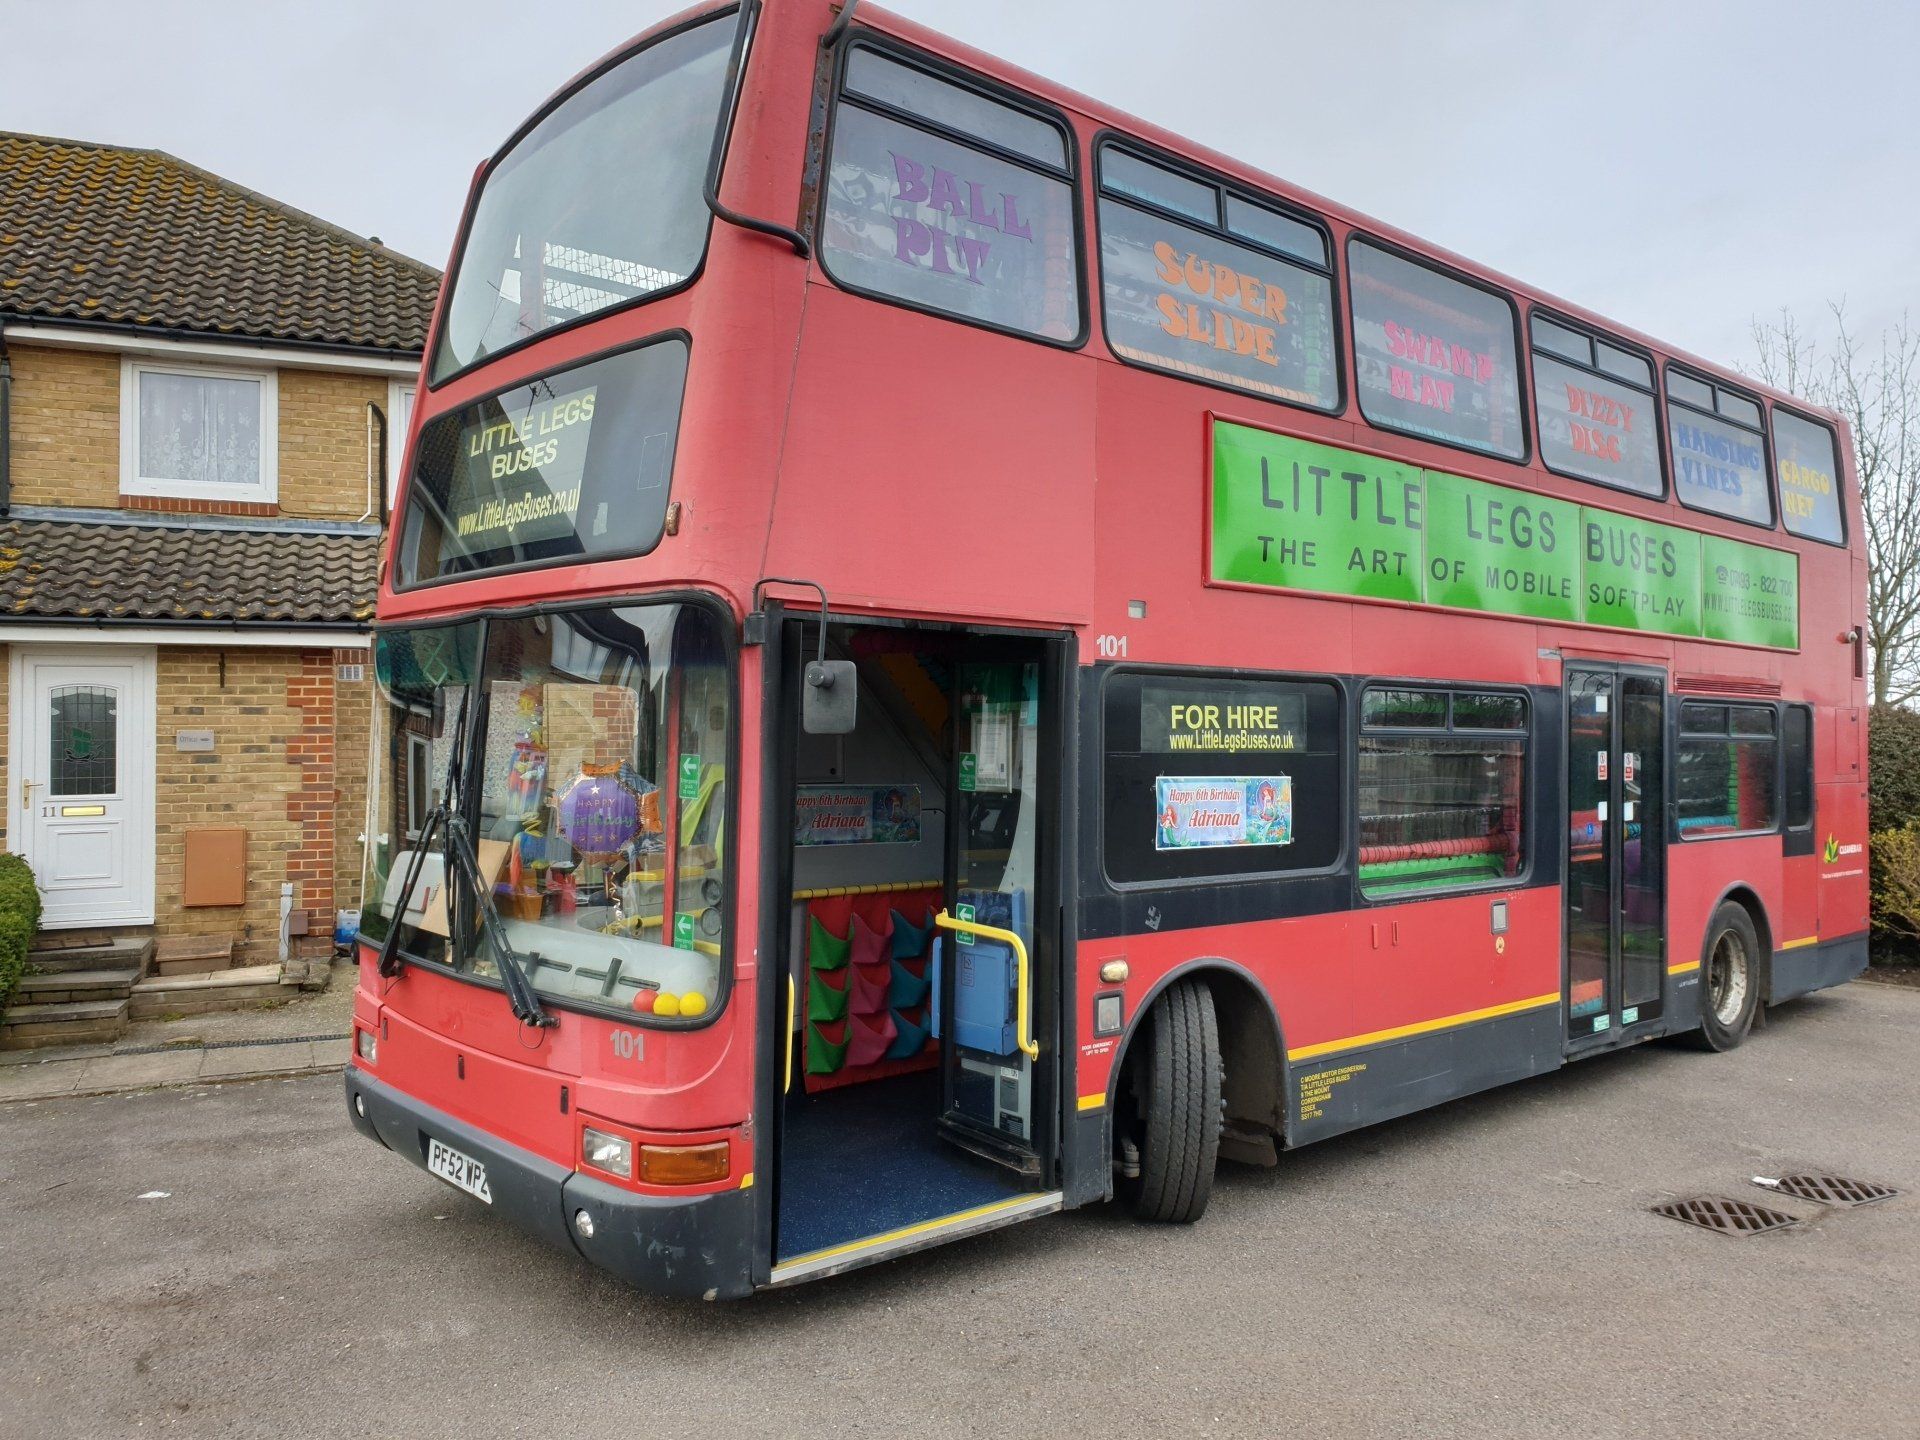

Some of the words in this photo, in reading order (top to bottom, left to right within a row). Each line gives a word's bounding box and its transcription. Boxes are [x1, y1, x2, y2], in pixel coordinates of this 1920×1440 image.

[888, 150, 1033, 243] BALL
[889, 216, 992, 286] PIT
[1152, 241, 1288, 325] SUPER
[1155, 293, 1281, 367] SLIDE
[1384, 319, 1494, 385] SWAMP
[1388, 364, 1455, 414] MAT
[1565, 382, 1635, 432] DIZZY
[470, 415, 534, 457] LITTLE
[539, 393, 597, 436] LEGS
[1568, 420, 1622, 464] DISC
[491, 438, 559, 479] BUSES
[1677, 422, 1760, 471] HANGING
[1681, 456, 1744, 497] VINES
[1779, 459, 1830, 496] CARGO
[1261, 455, 1422, 530] LITTLE
[1465, 494, 1556, 553] LEGS
[1586, 522, 1677, 578] BUSES
[1783, 490, 1815, 519] NET
[1257, 535, 1317, 567] THE
[1348, 546, 1408, 576] ART
[1430, 557, 1466, 583] OF
[1486, 565, 1572, 599] MOBILE
[1589, 583, 1685, 617] SOFTPLAY
[1760, 575, 1777, 593] 822
[1096, 634, 1127, 657] 101
[1171, 705, 1220, 729] FOR
[1227, 705, 1279, 729] HIRE
[1169, 729, 1294, 752] www.LittleLegsBuses.co.uk
[41, 806, 57, 818] 11
[577, 798, 616, 807] HAPPY
[797, 796, 817, 809] appy
[1169, 789, 1194, 804] Happy
[1196, 788, 1209, 801] 6th
[1209, 788, 1242, 803] Birthday
[811, 812, 866, 829] Adriana
[1188, 809, 1241, 828] Adriana
[610, 1029, 644, 1061] 101
[433, 1144, 463, 1181] PF52
